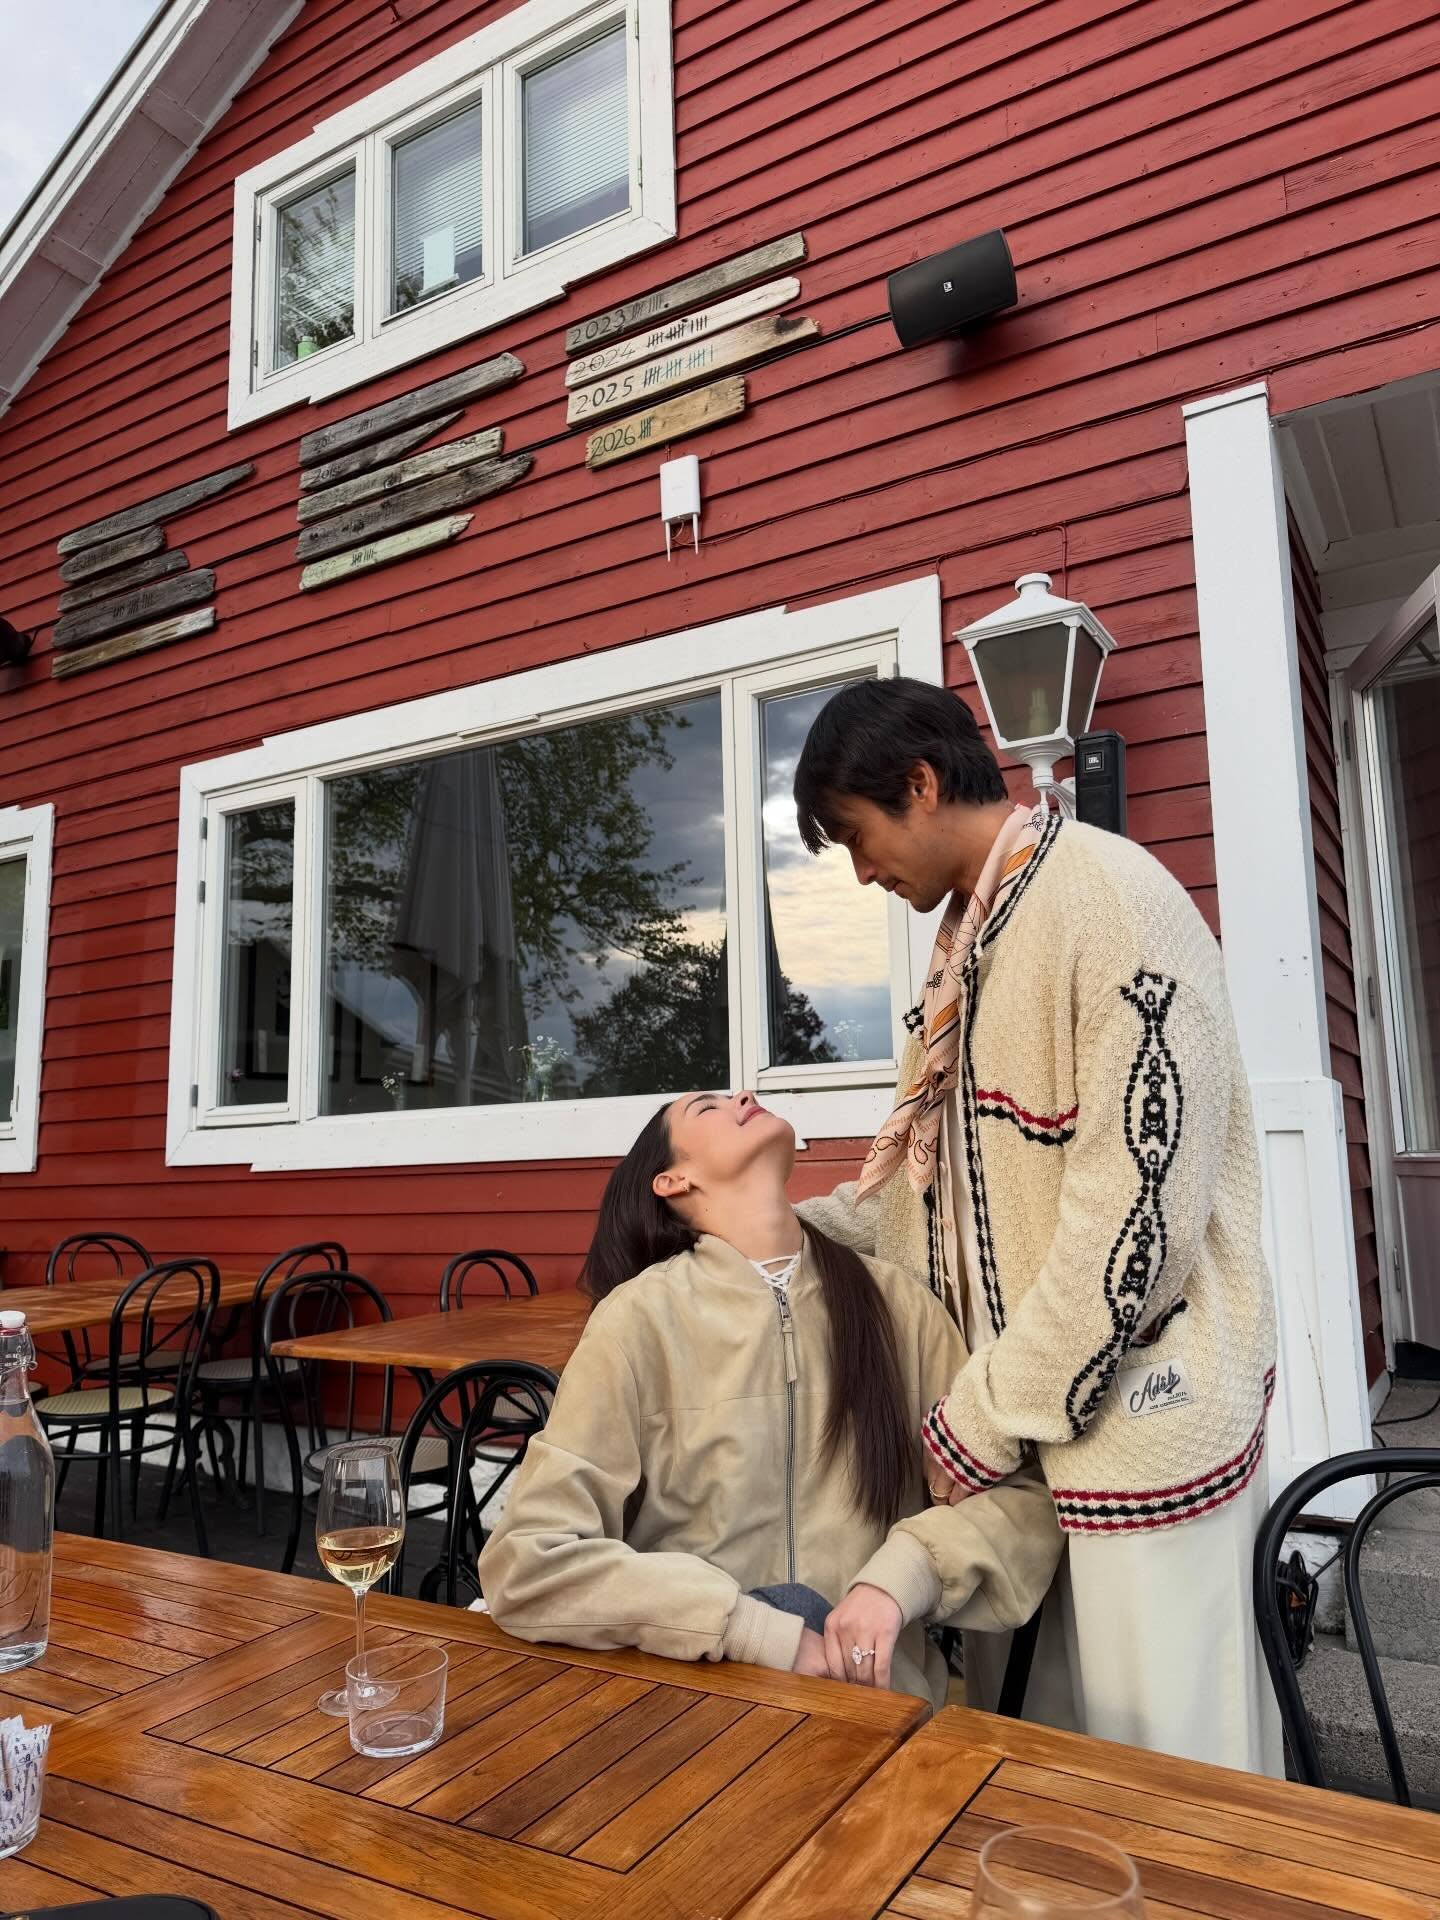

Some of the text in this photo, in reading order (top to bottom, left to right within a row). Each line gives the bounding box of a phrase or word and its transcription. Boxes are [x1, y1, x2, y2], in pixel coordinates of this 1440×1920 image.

[570, 309, 626, 345] 2023
[570, 342, 636, 380] 2024
[575, 375, 635, 414] 2025
[590, 425, 636, 458] 2026
